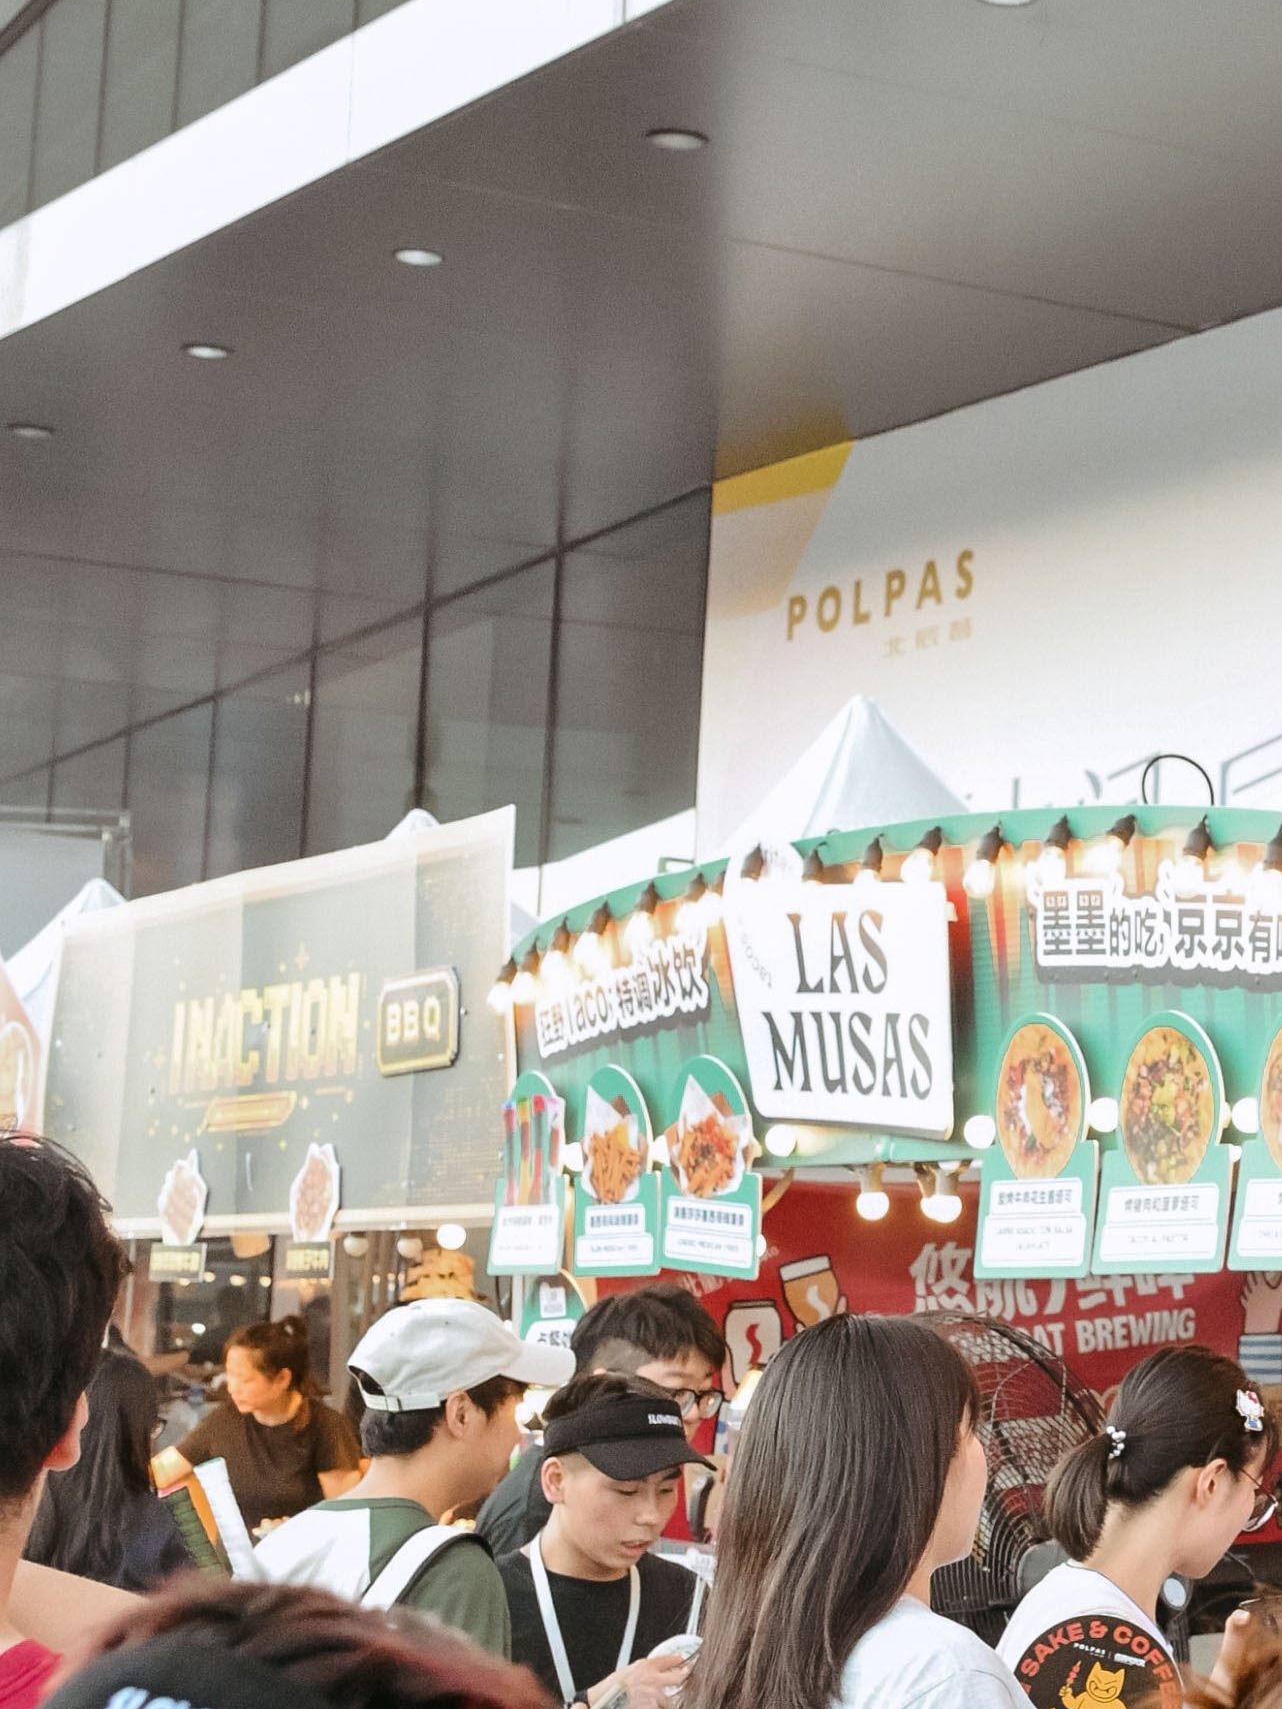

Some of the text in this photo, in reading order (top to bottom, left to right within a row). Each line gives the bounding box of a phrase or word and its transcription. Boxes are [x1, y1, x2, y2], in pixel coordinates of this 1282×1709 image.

[785, 548, 976, 643] POLPAS
[786, 909, 888, 995] LAS
[386, 995, 441, 1046] BBQ
[760, 1010, 933, 1100] MUSAS
[1075, 1307, 1196, 1354] BREWING
[1020, 1621, 1085, 1678] SAKE
[1089, 1620, 1108, 1639] &
